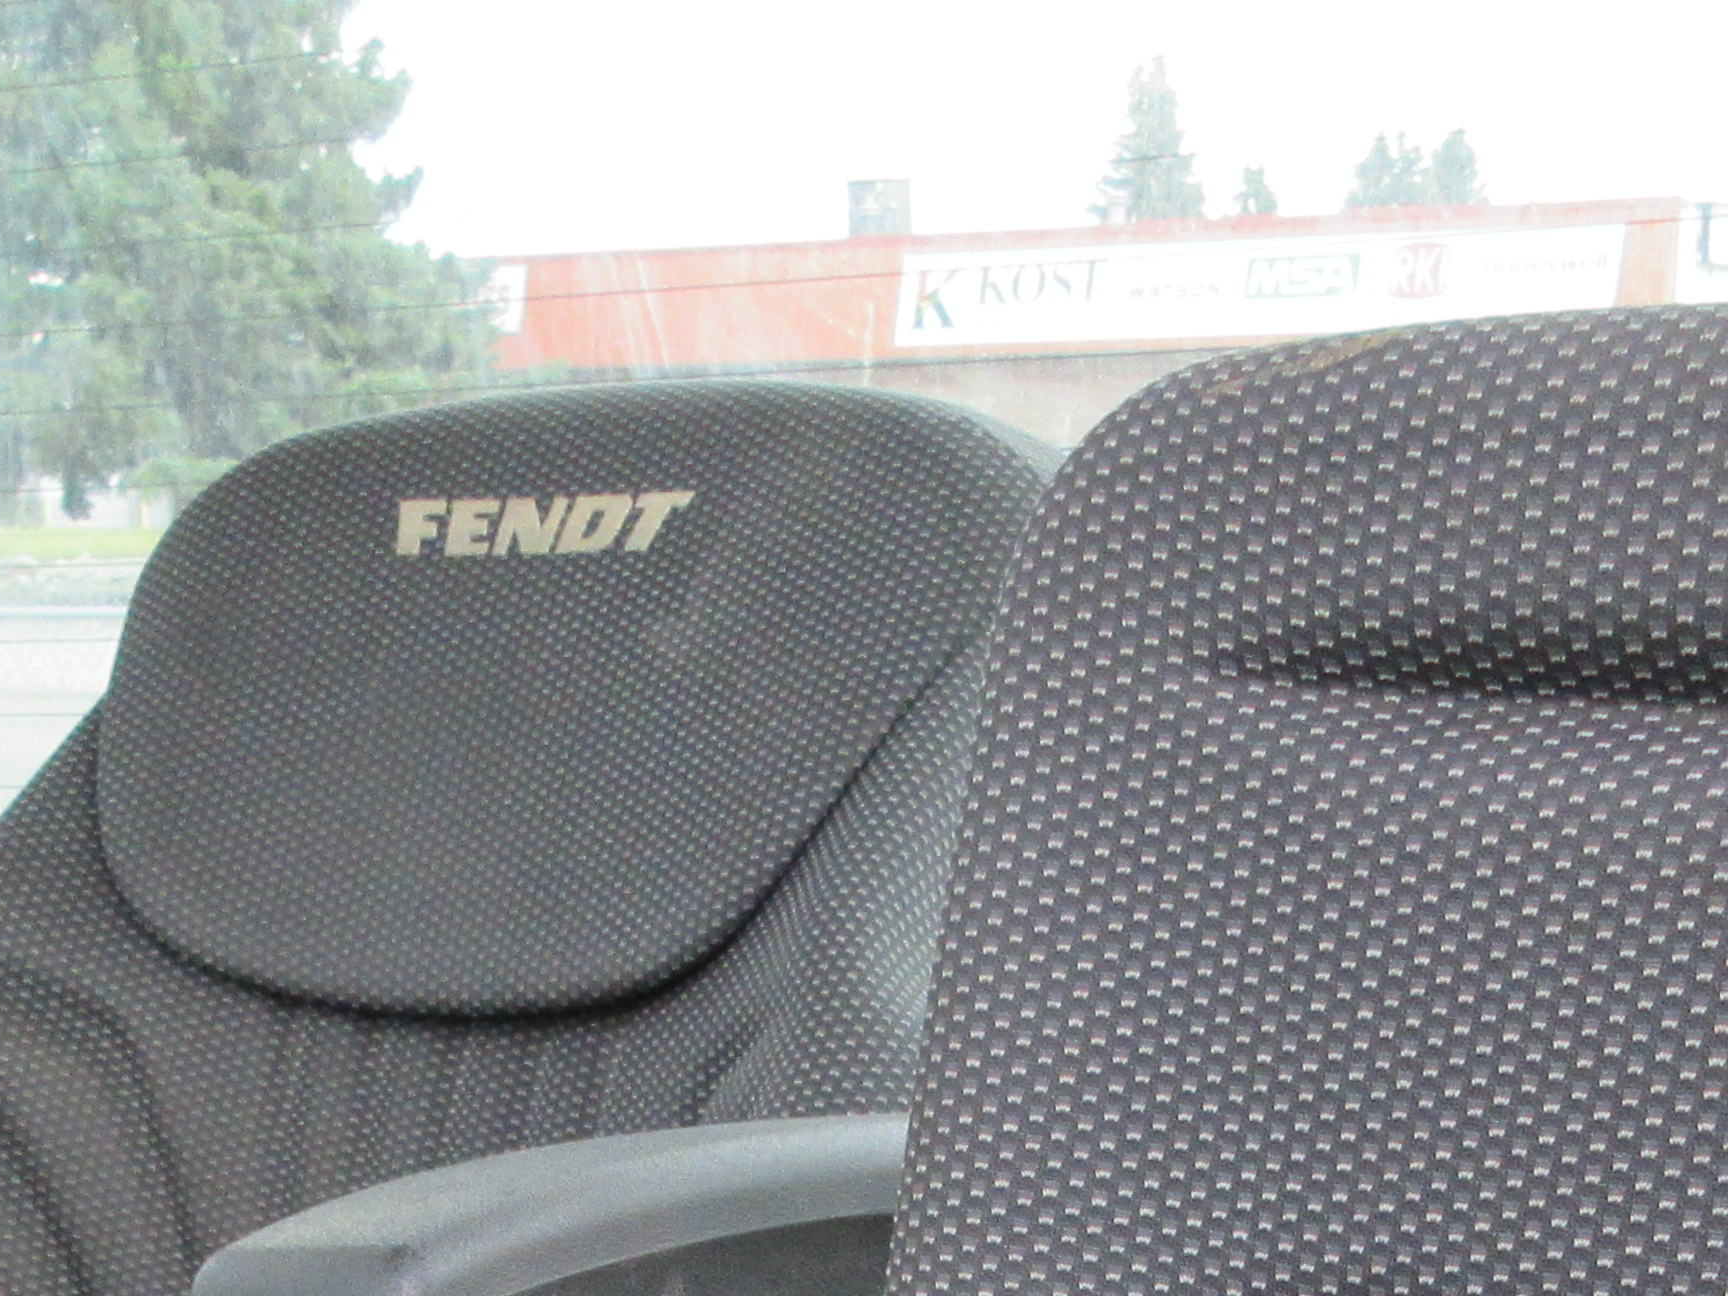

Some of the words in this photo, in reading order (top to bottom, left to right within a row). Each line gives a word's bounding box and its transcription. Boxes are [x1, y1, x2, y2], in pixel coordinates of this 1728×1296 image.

[977, 259, 1108, 305] KOST
[1246, 254, 1361, 298] MSA
[395, 490, 697, 557] FENDT
